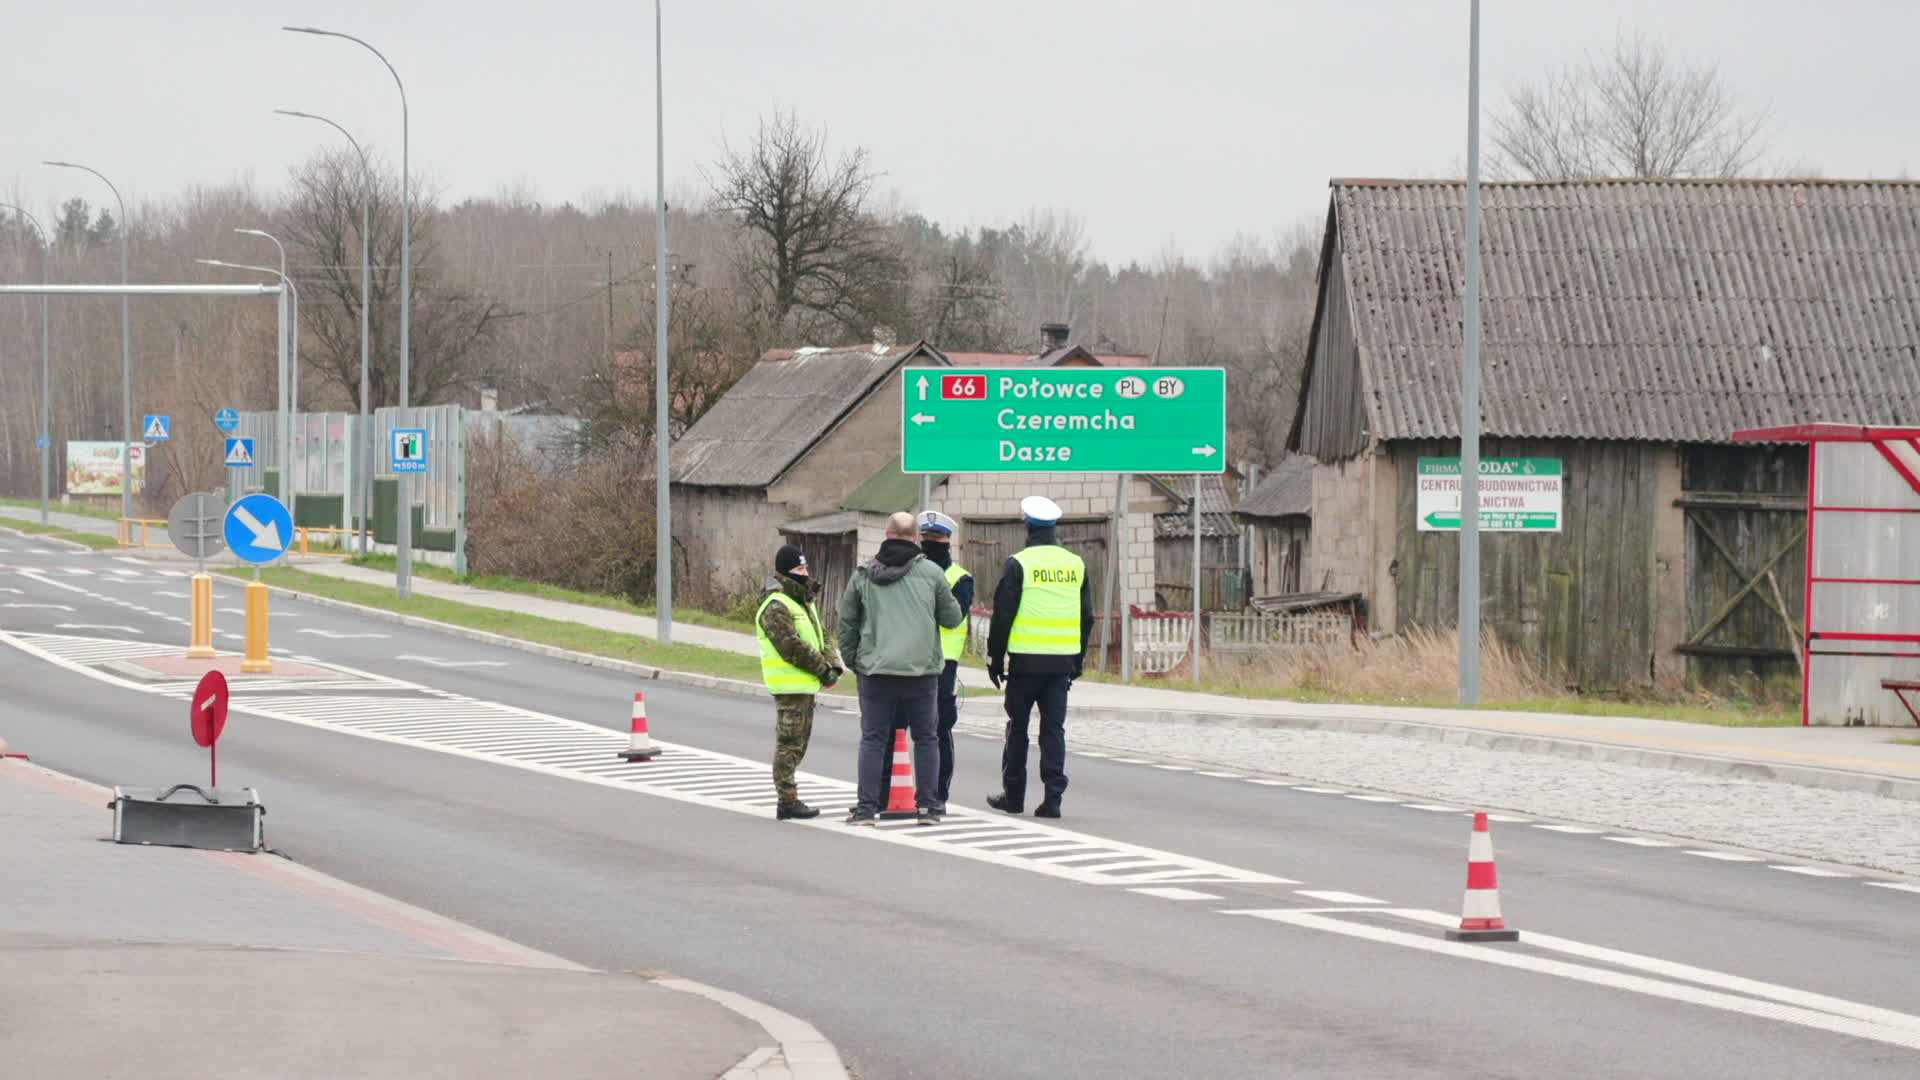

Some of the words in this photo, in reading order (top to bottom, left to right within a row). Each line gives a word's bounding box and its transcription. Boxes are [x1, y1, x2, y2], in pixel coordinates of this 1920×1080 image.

[951, 378, 976, 396] 66
[999, 377, 1104, 399] Połowce
[1120, 379, 1140, 395] PL
[1158, 379, 1178, 395] BY
[997, 408, 1136, 430] Czeremcha
[999, 440, 1073, 461] Dasze
[1425, 463, 1459, 473] FIRMA
[1459, 461, 1519, 473] "ODA"
[1421, 479, 1462, 491] CENTRU
[1478, 479, 1559, 491] BUDOWNICTWA
[1033, 569, 1078, 583] POLICJA
